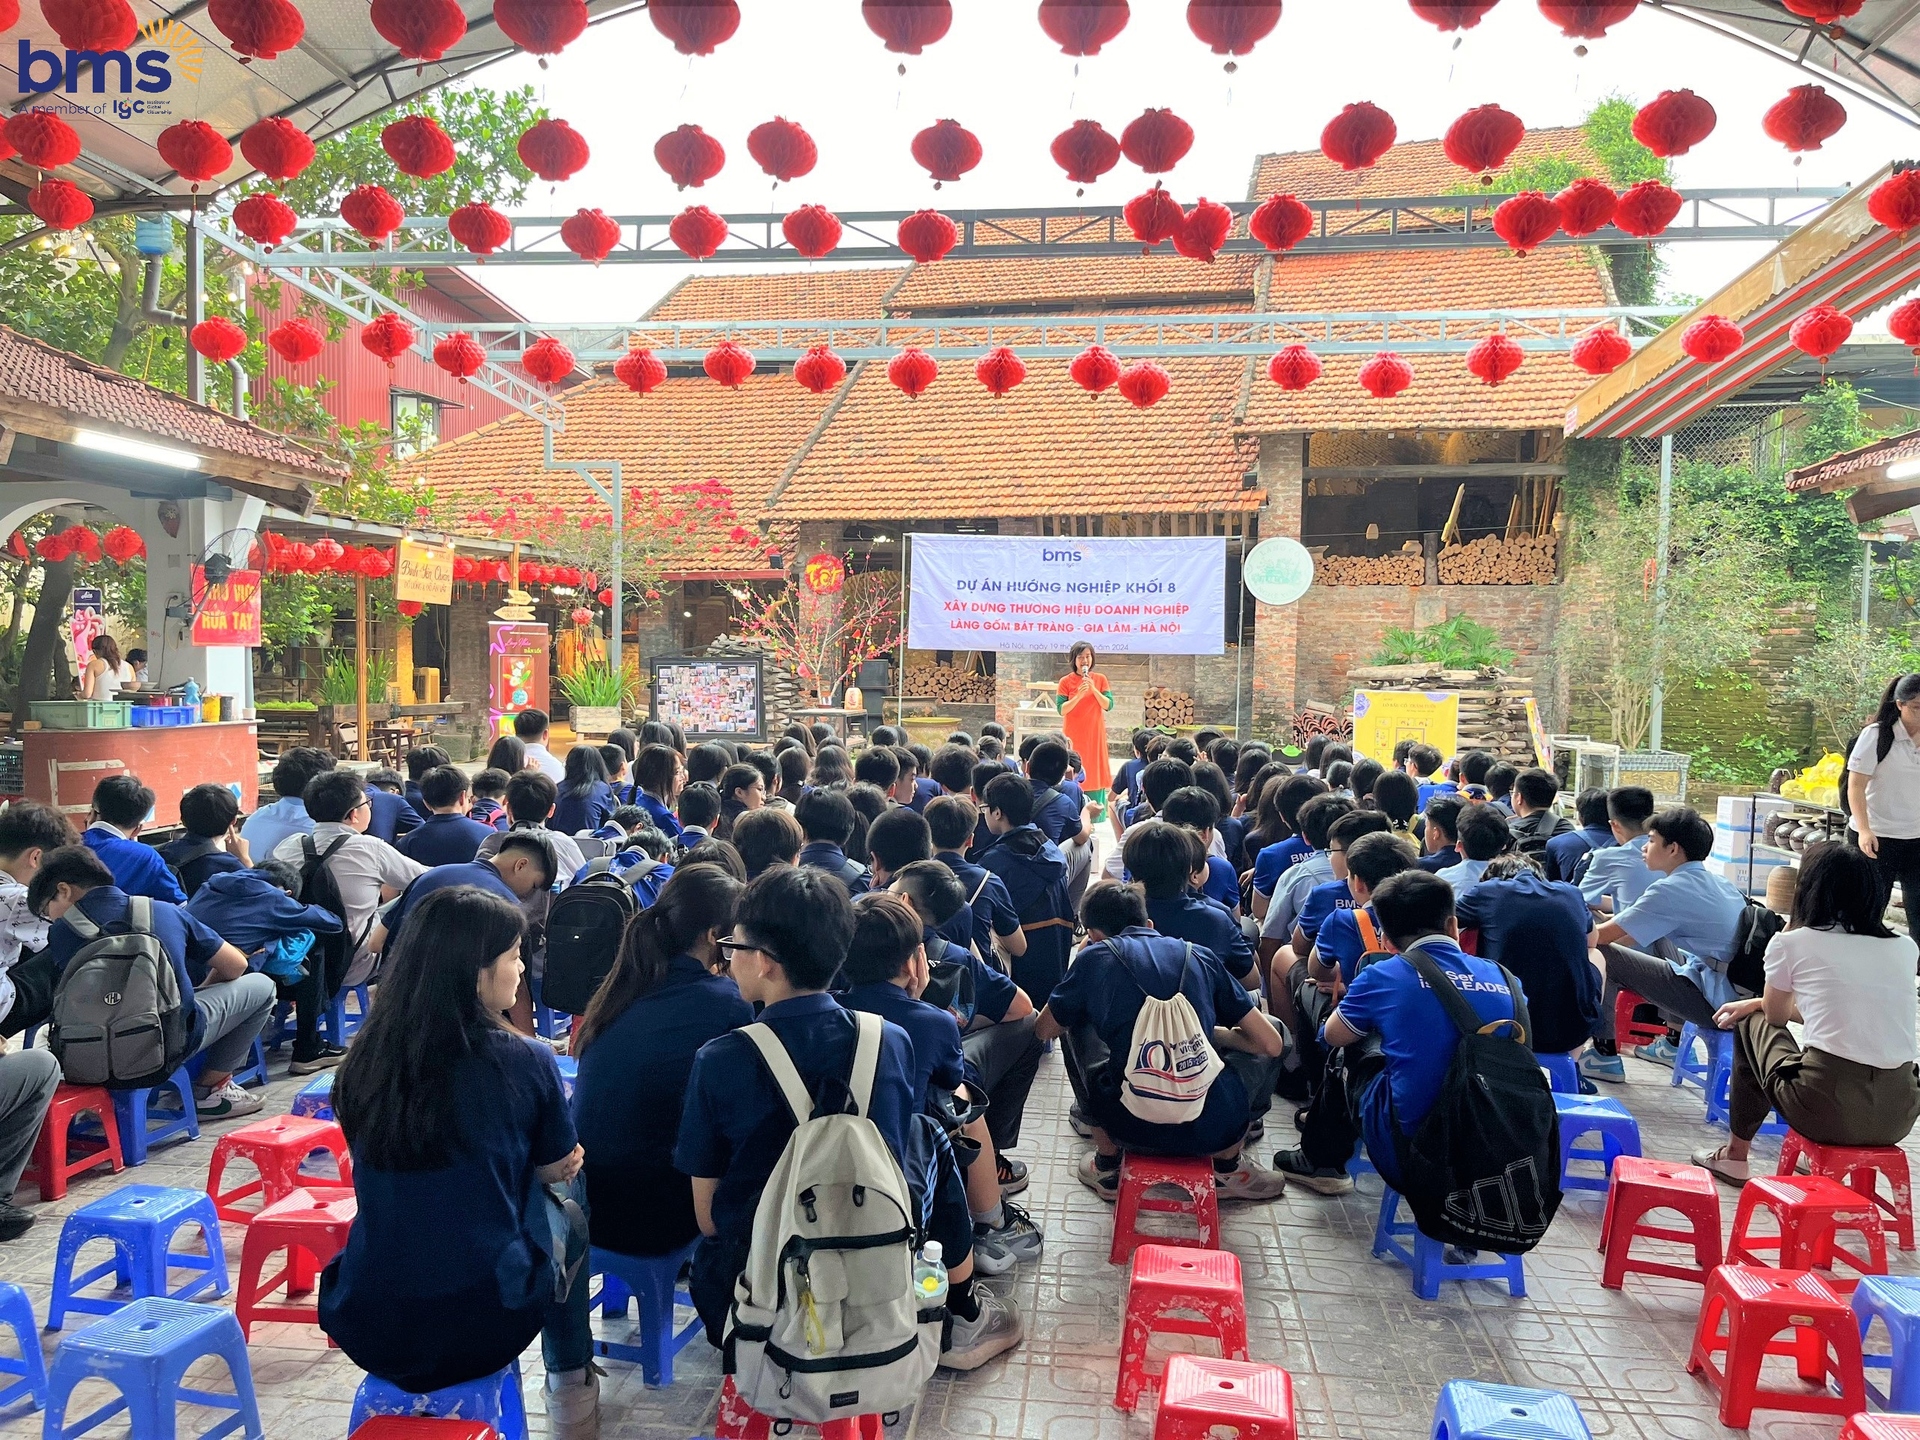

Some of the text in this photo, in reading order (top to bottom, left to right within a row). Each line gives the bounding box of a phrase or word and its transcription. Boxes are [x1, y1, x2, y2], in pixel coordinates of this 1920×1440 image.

[1042, 548, 1082, 562] bms
[956, 577, 1176, 596] DỰ ÁN HƯỚNG NGHIỆP KHỐI 8
[943, 599, 1190, 617] XÂY DỰNG THƯƠNG HIỆU DOANH NGHIỆP
[232, 611, 253, 631] TAY
[950, 618, 980, 630] LÀNG
[983, 618, 1010, 631] GỐM
[1014, 620, 1034, 632] BÁT
[1037, 621, 1075, 632] TRÀNG
[1084, 623, 1105, 633] GIA
[1108, 622, 1131, 633] LÂM
[1140, 622, 1157, 633] HÀ
[1160, 622, 1181, 635] NỘI
